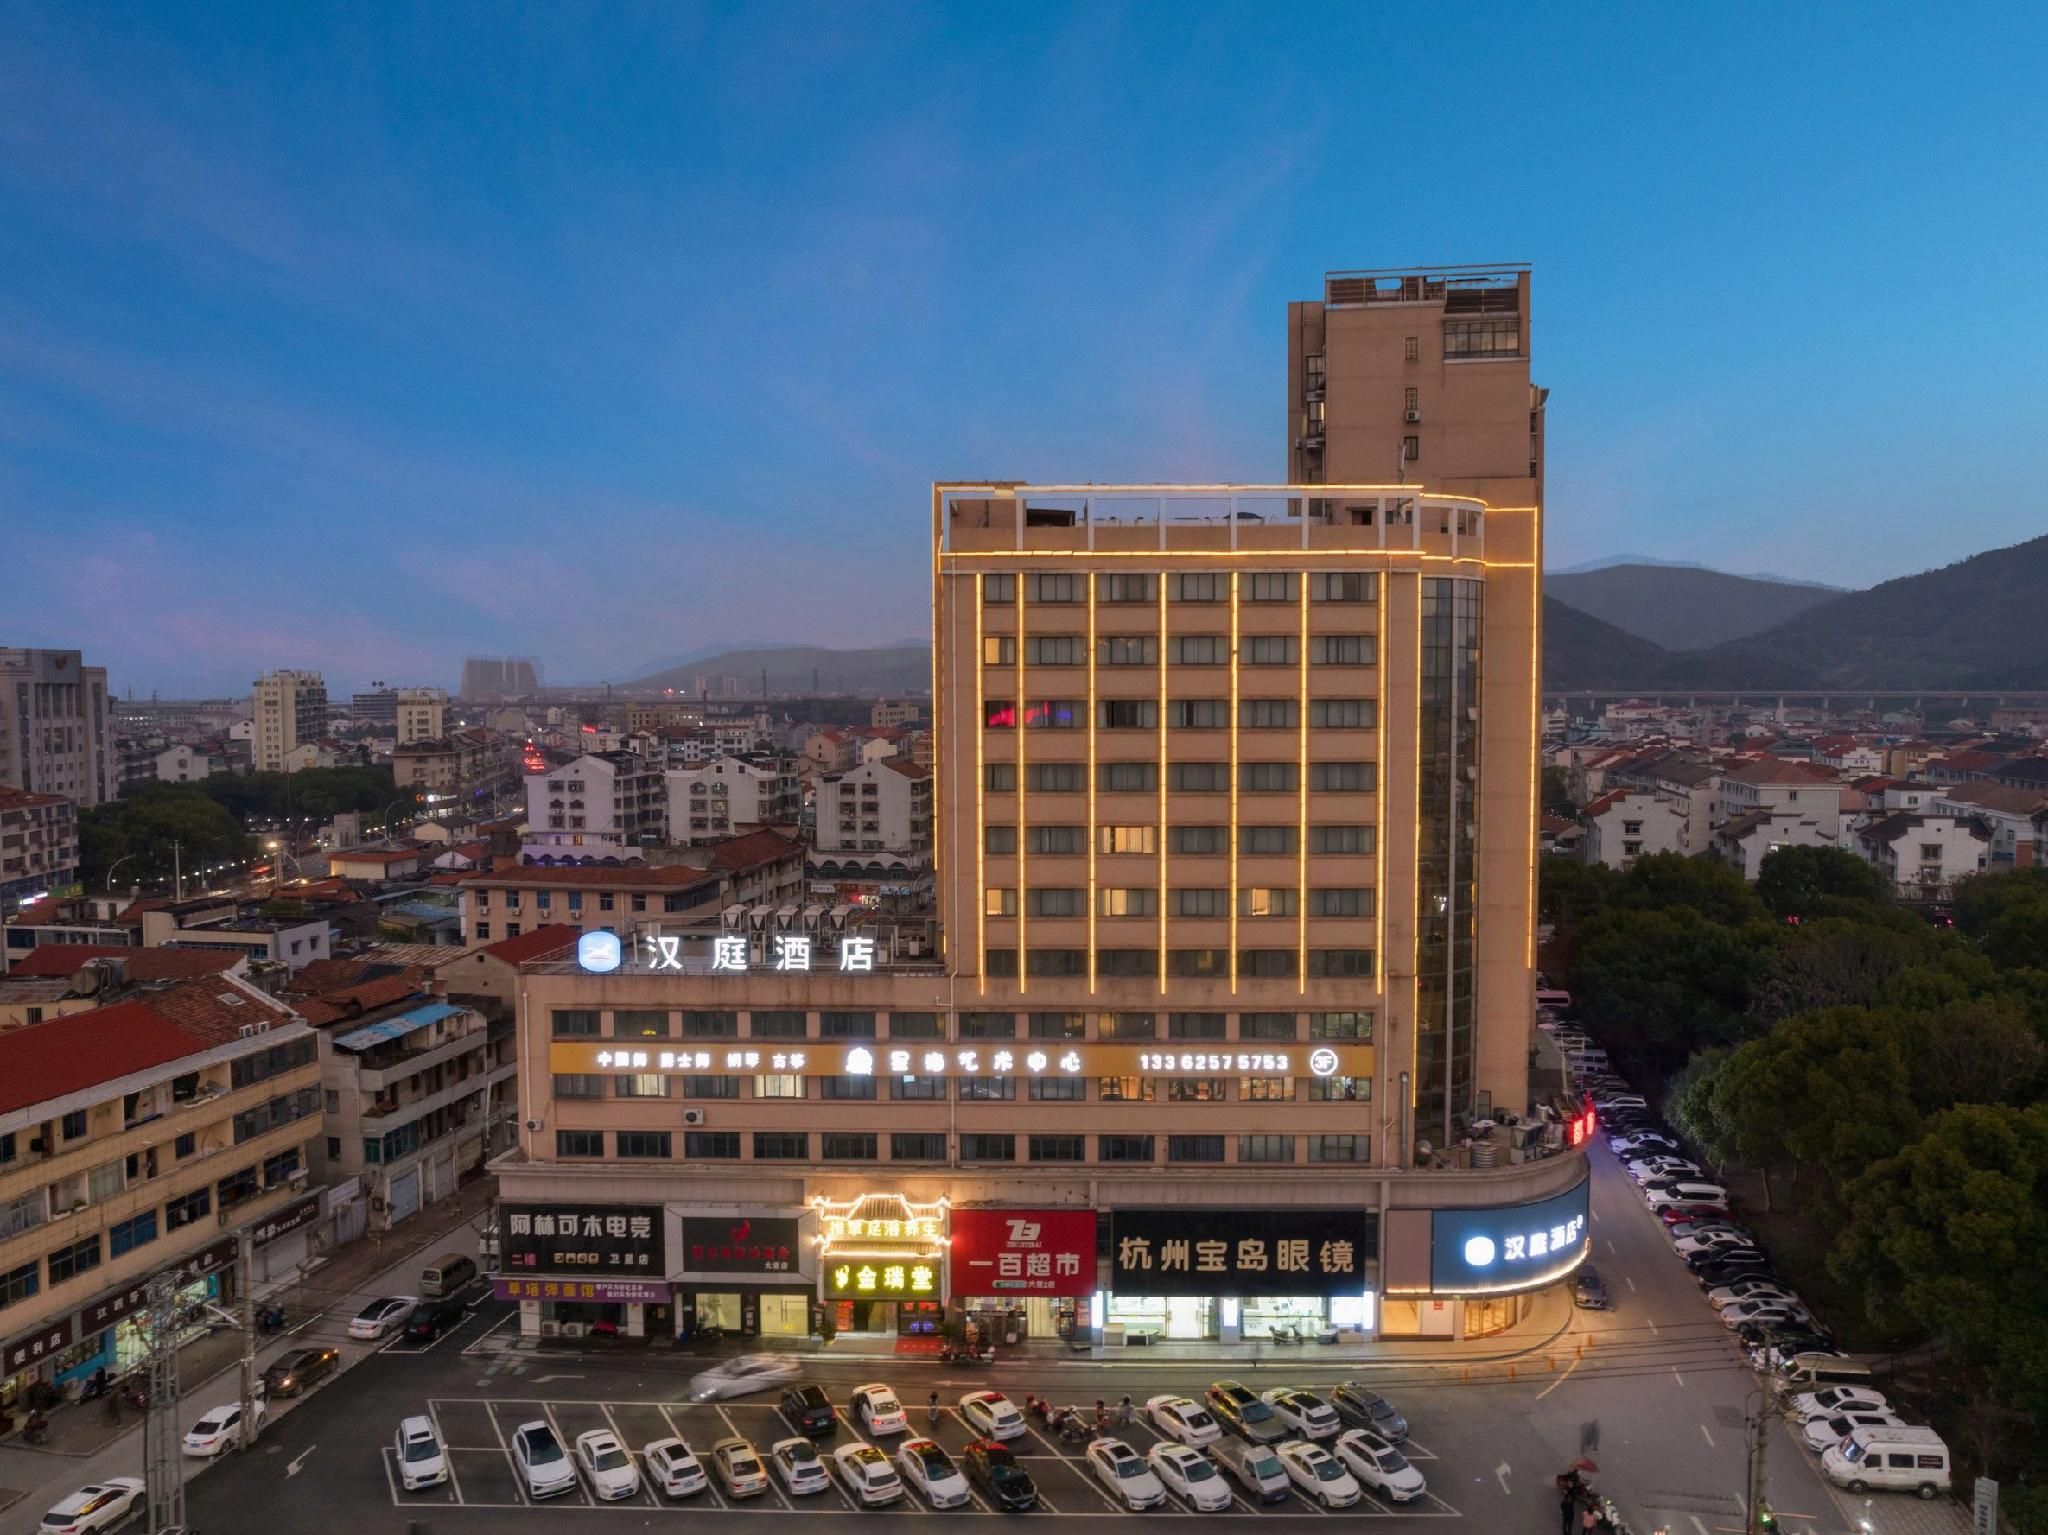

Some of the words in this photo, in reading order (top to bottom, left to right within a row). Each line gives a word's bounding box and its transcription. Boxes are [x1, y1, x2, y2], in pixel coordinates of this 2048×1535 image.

[648, 935, 874, 972] 汉庭酒店
[1118, 1236, 1355, 1273] 杭州宝岛眼镜
[1504, 1219, 1577, 1260] 汉庭酒店
[856, 1265, 933, 1290] 金瑞堂
[969, 1252, 1081, 1277] 一百超市
[14, 1332, 62, 1366] 便利店
